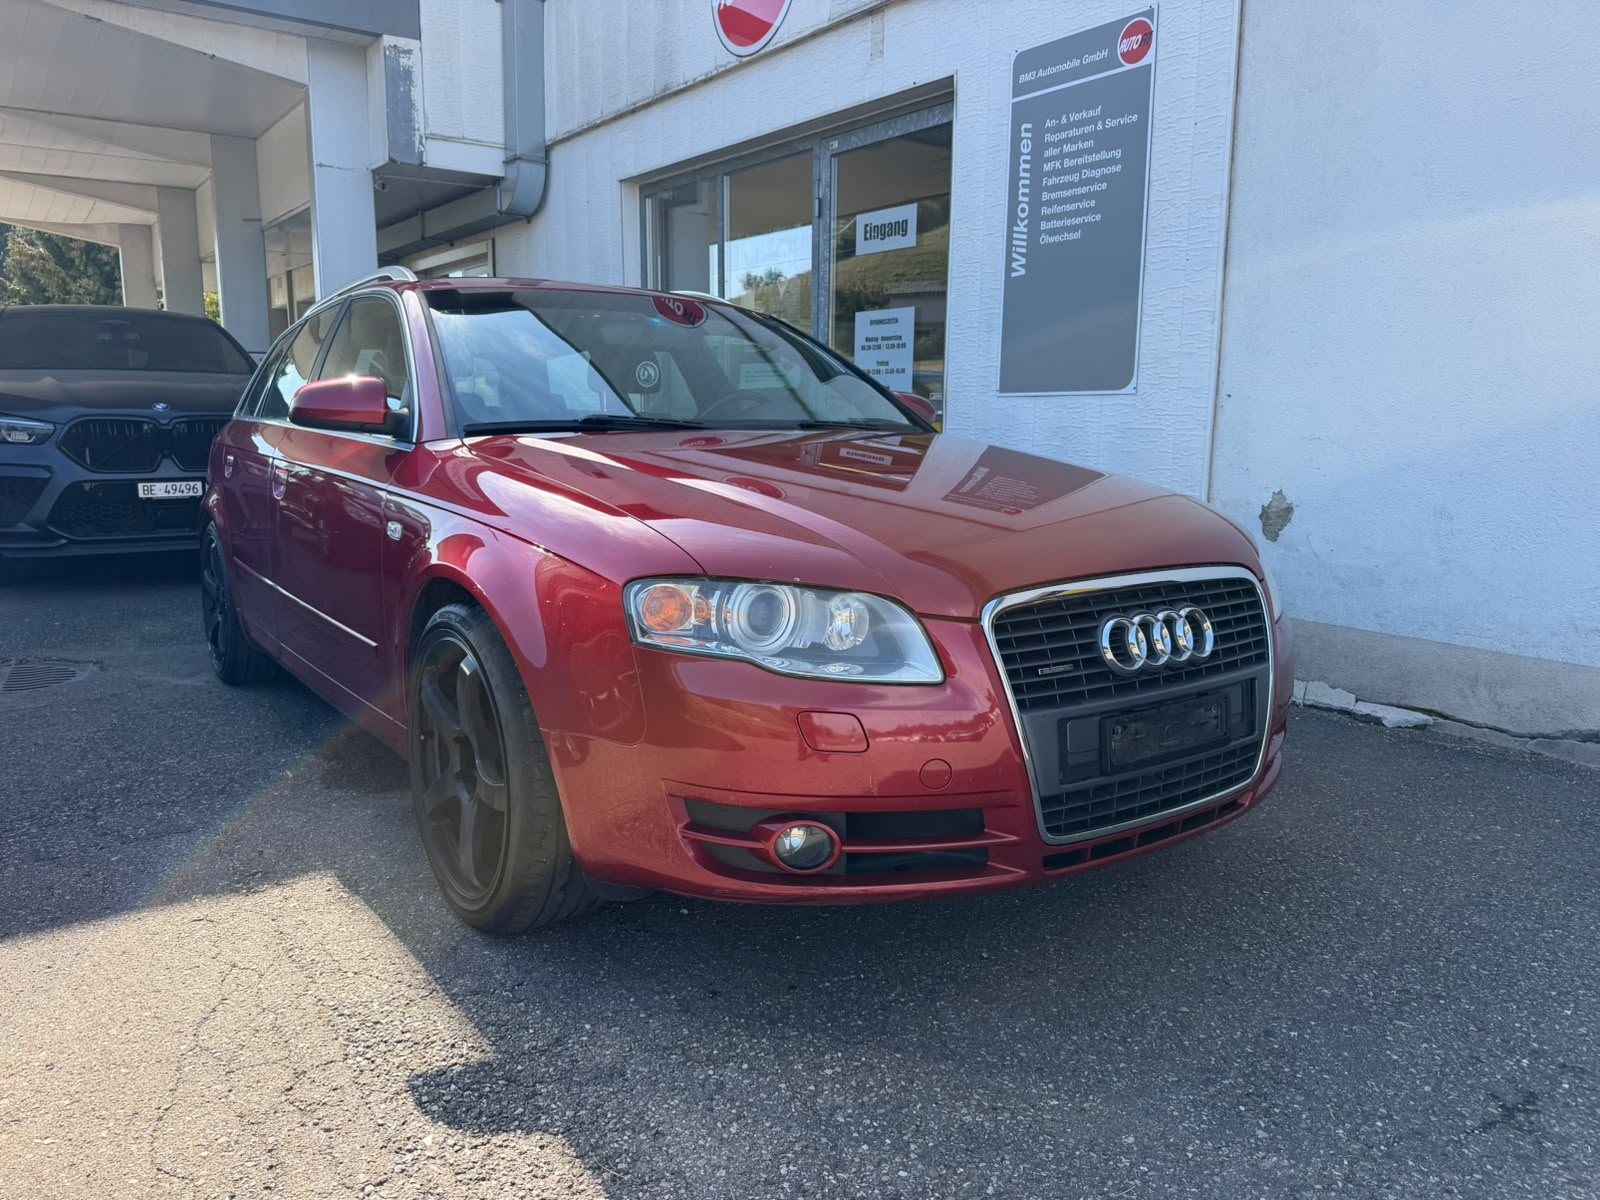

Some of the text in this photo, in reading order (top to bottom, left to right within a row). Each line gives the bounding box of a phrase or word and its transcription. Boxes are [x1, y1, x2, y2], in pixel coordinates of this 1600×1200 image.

[1018, 48, 1109, 84] BM3 Automobile GmbH
[1044, 105, 1102, 129] An- & Verkauf
[1044, 113, 1138, 143] Reparaturen & Service
[1043, 139, 1094, 158] aller Marken
[1043, 148, 1122, 173] MFK Bereitstellung
[1042, 163, 1122, 187] Fahrzeug Diagnose
[1010, 123, 1032, 278] Willkommen
[1041, 181, 1107, 201] Bremsenservice
[1041, 199, 1096, 216] Reifenservice
[863, 219, 908, 242] Eingang
[1040, 213, 1102, 231] Batterieservice
[1039, 230, 1081, 245] Ölwechsel
[142, 483, 199, 496] BE 49496
